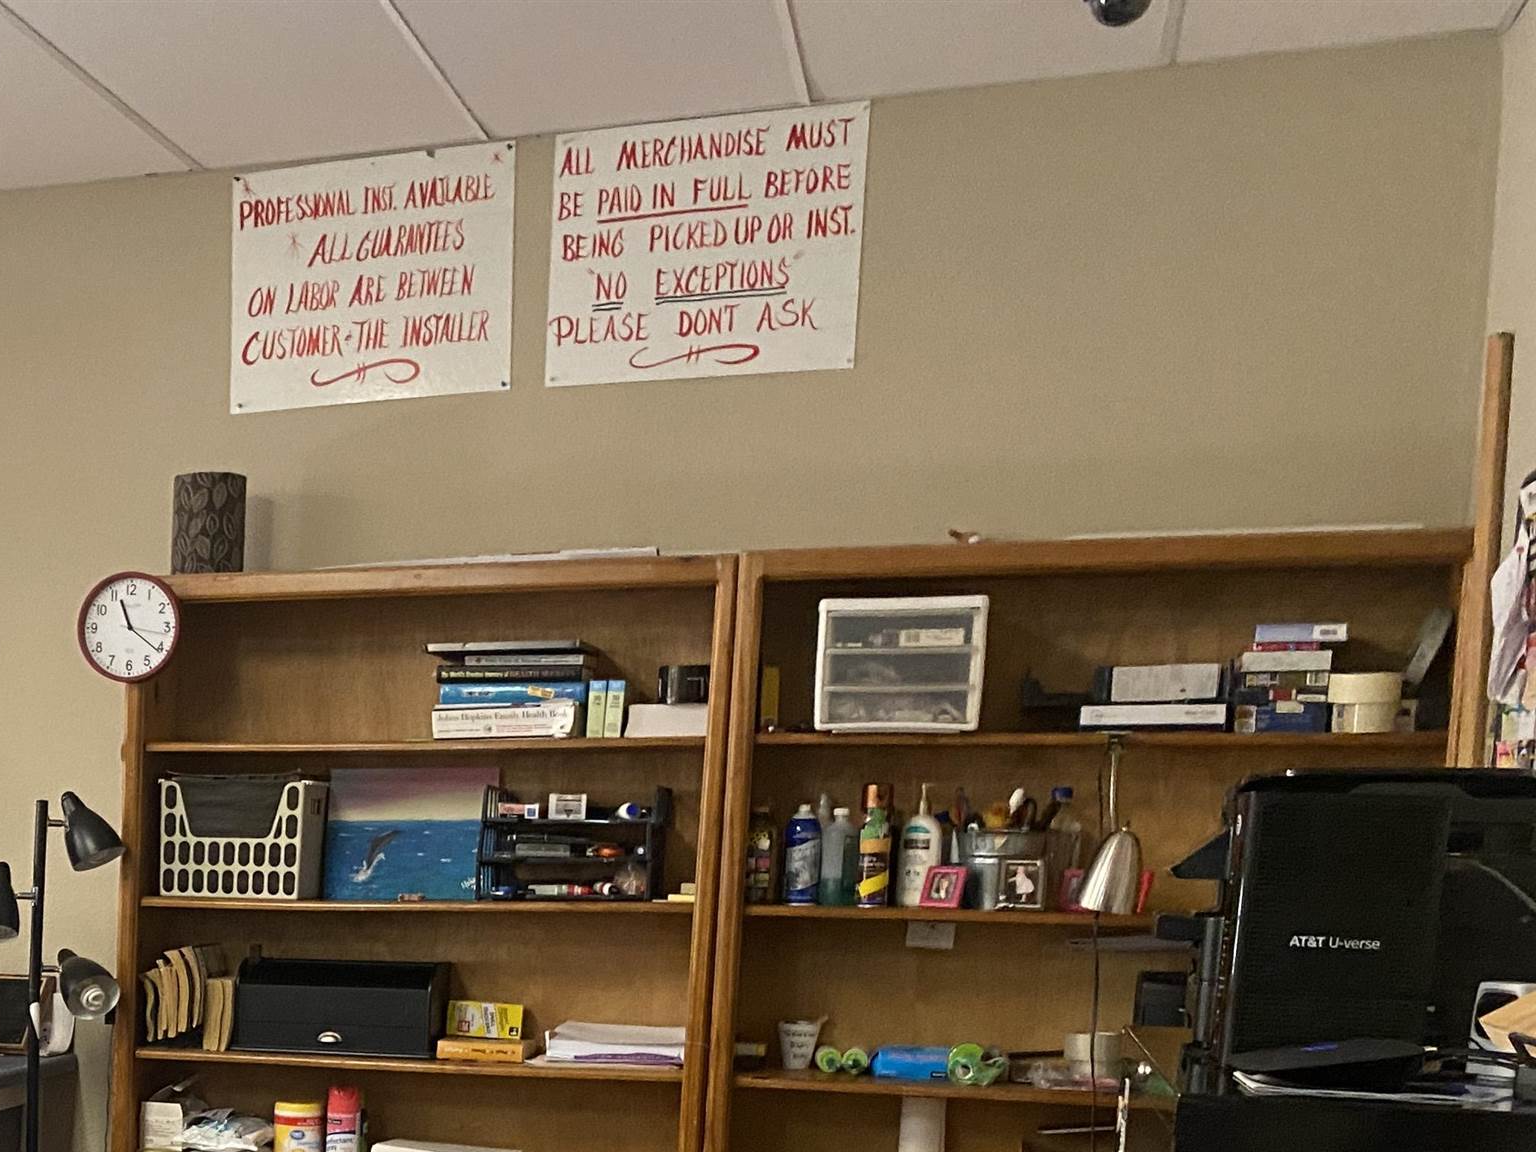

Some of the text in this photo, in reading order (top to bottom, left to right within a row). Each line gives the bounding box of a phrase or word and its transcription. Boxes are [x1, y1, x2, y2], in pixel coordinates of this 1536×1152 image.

[560, 117, 856, 178] ALL MERCHANDISE MUST
[239, 189, 355, 231] PROFESSIONAL
[404, 173, 495, 209] AVAILABLE
[558, 164, 851, 221] BE PAID IN FULL BEFORE
[308, 218, 465, 267] ALL GUARANTEES
[562, 204, 856, 261] BEING PICKED UP OR INST.
[248, 264, 475, 318] ON LABOR ARE BETWEEN
[242, 325, 343, 365] CUSTOMER
[352, 318, 388, 352] THE
[403, 310, 489, 347] INSTALLER
[549, 313, 650, 346] PLEASE
[757, 297, 818, 332] ASK
[1289, 935, 1381, 950] AT&T U-verse
